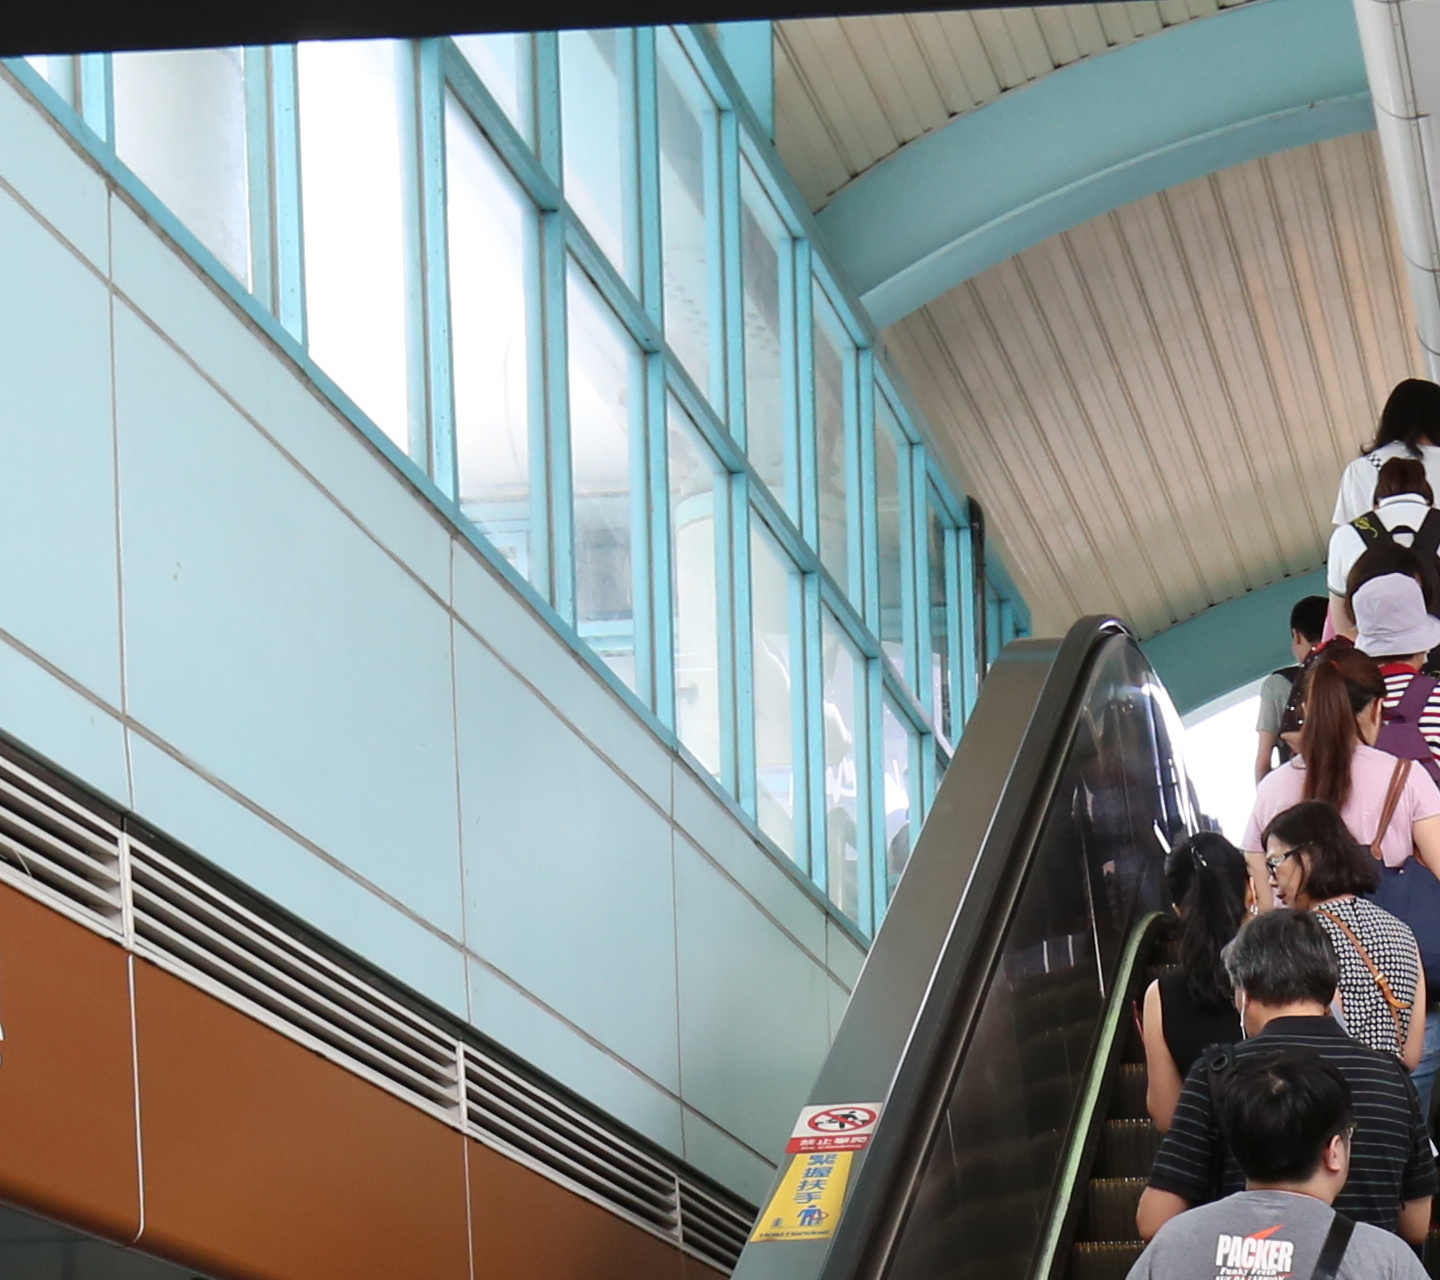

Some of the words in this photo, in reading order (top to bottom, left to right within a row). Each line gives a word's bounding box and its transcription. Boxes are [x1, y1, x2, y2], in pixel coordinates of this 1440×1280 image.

[793, 1154, 839, 1204] 緊握扶手
[1215, 1234, 1295, 1273] PACKER
